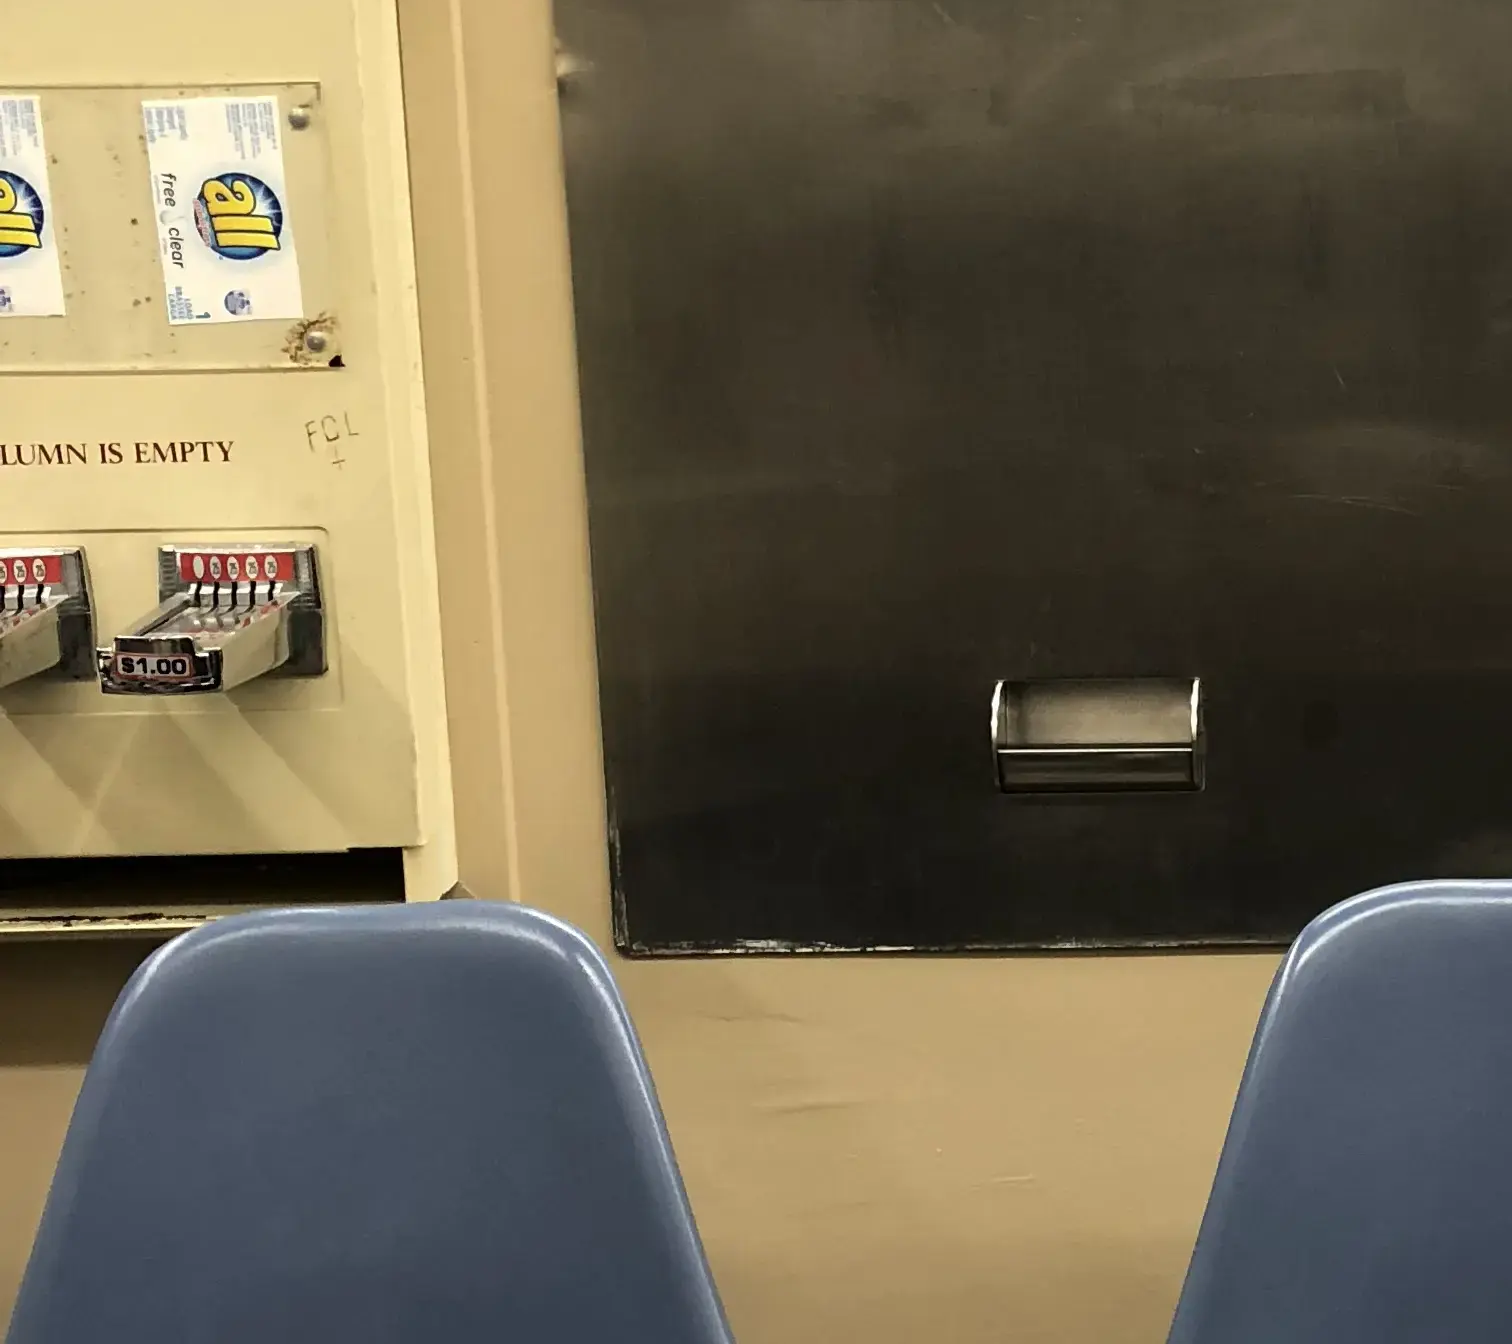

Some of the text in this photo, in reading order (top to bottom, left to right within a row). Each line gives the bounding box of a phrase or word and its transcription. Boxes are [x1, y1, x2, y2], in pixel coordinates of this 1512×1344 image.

[161, 173, 184, 269] free clear
[201, 178, 281, 251] all
[99, 442, 123, 464] IS
[135, 440, 235, 464] EMPTY
[120, 658, 187, 676] $1.00
